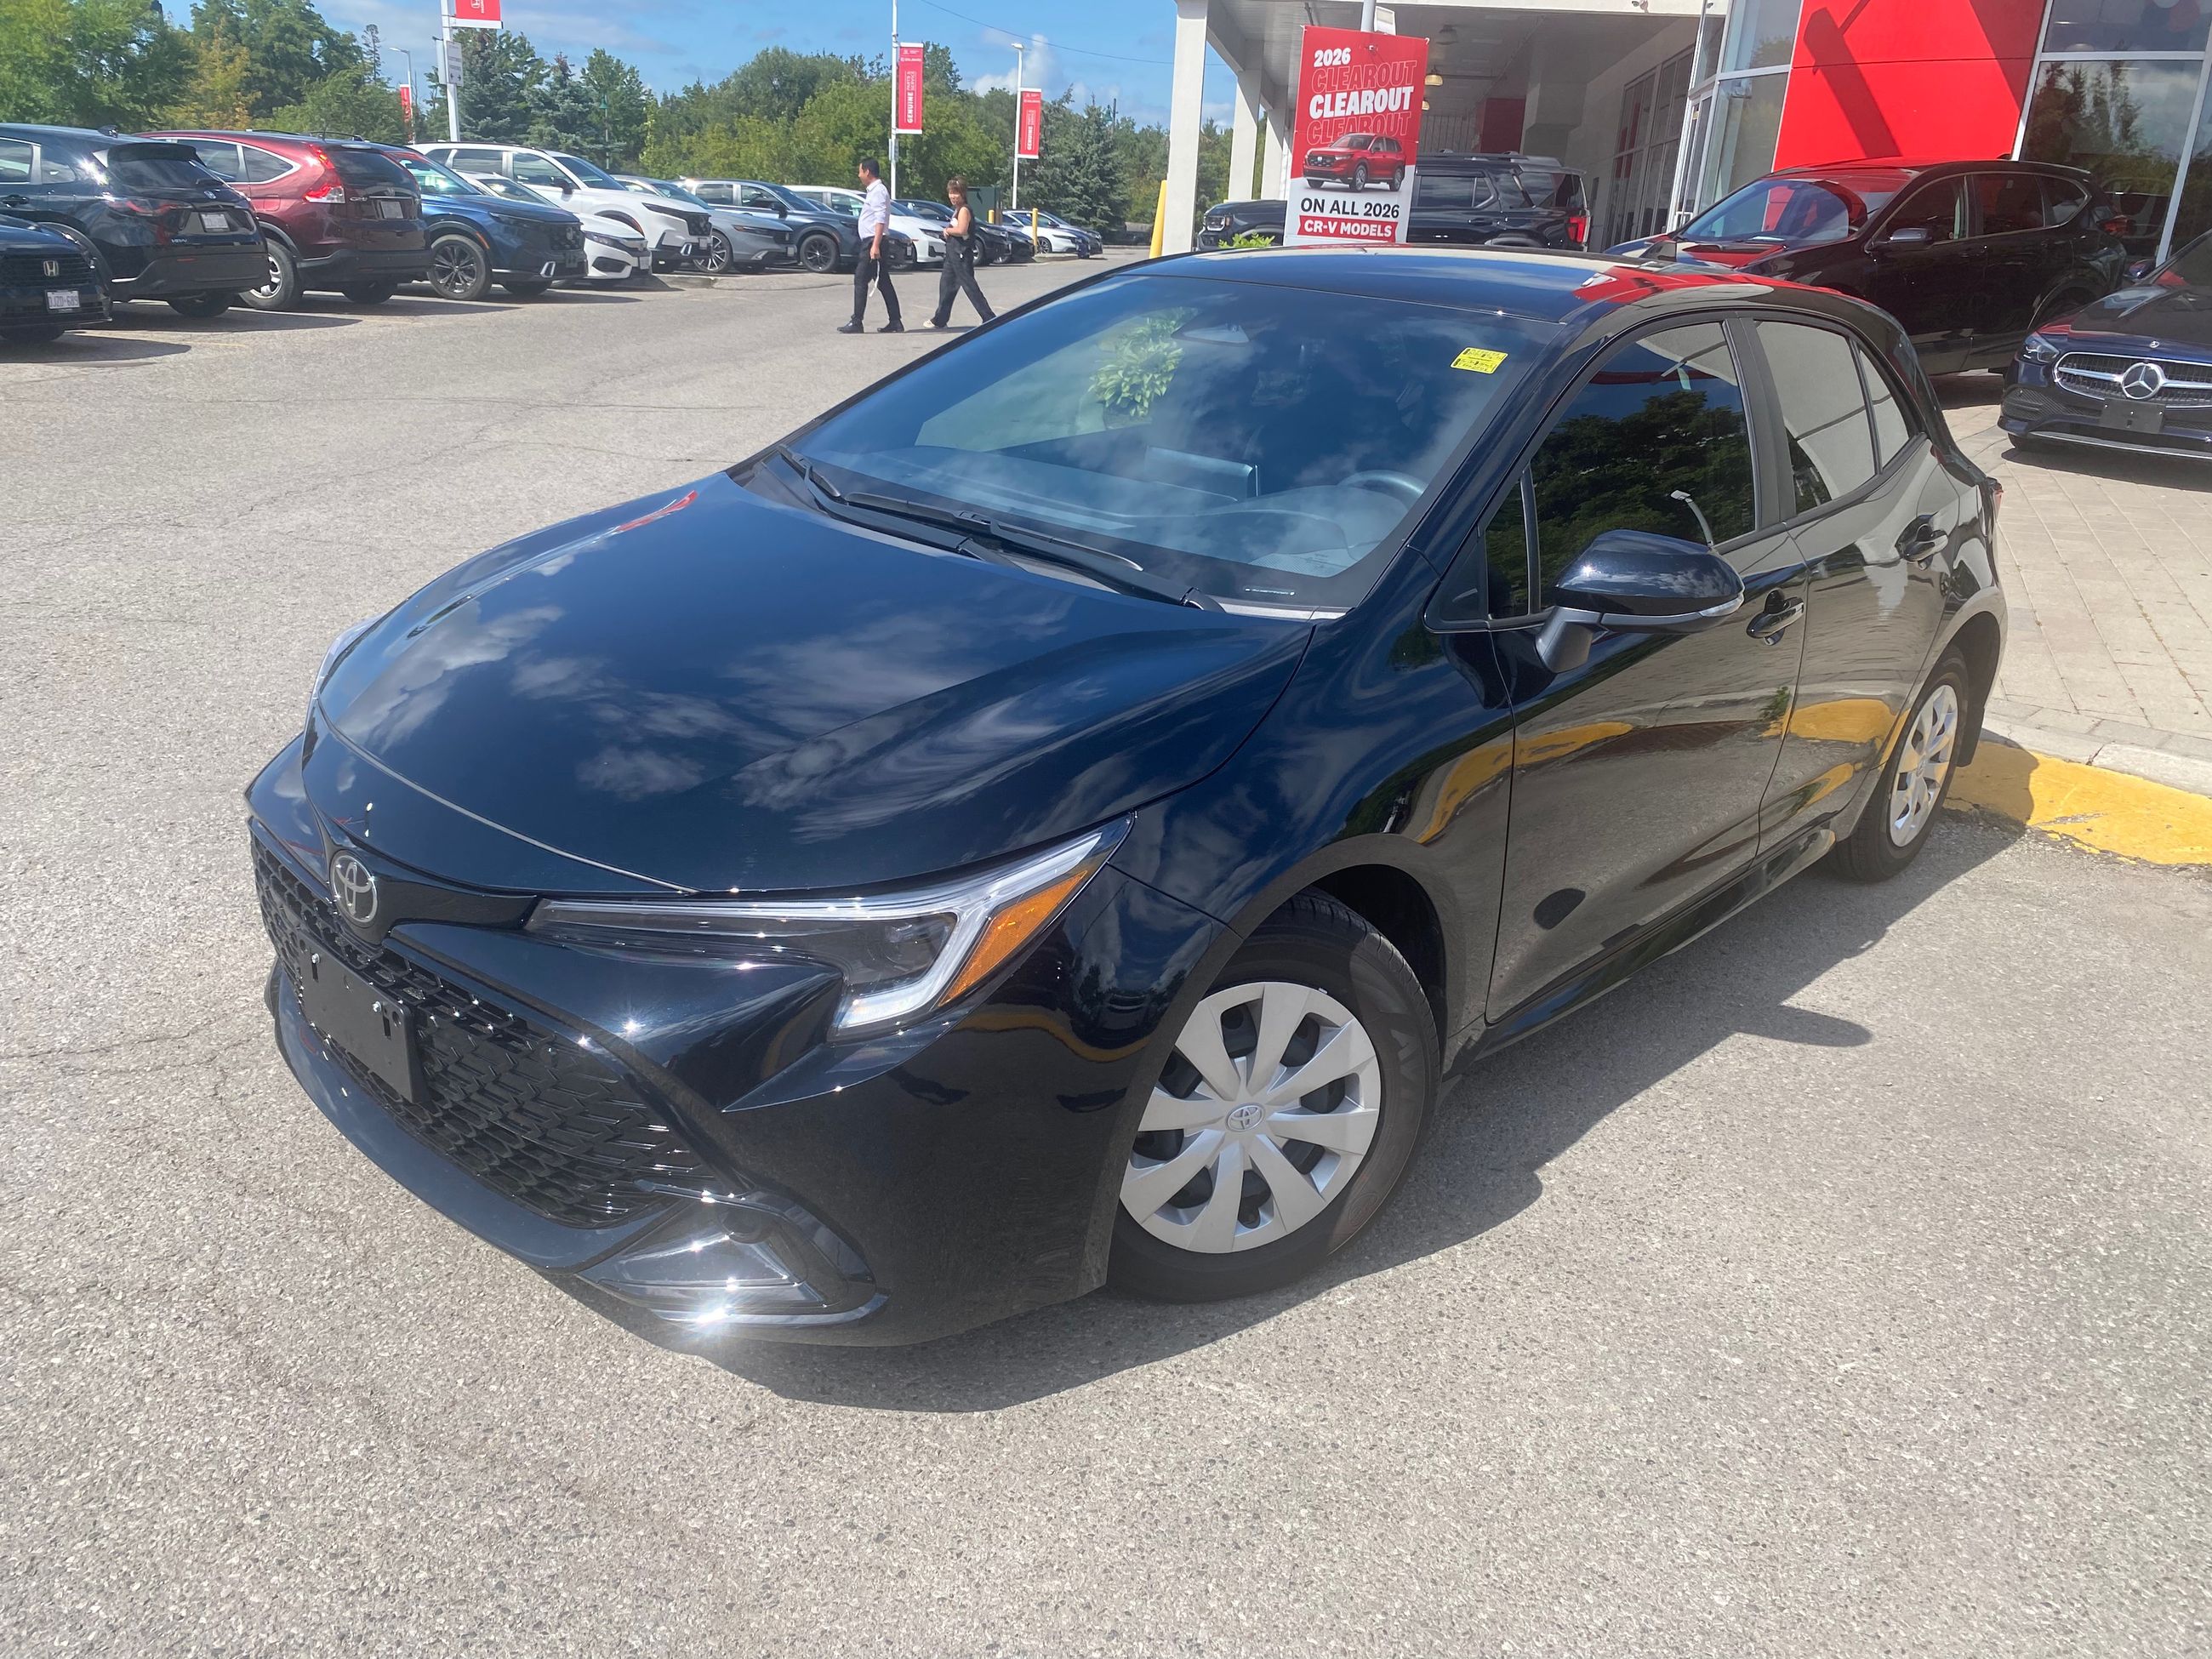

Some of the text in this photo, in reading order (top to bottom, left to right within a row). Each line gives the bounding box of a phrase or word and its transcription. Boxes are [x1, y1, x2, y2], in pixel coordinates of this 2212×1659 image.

[1314, 48, 1351, 67] 2026
[1311, 60, 1417, 94] CLEAROUT
[1309, 86, 1414, 119] CLEAROUT
[1301, 197, 1400, 218] ON ALL 2026
[1304, 219, 1392, 237] CR-V MODELS
